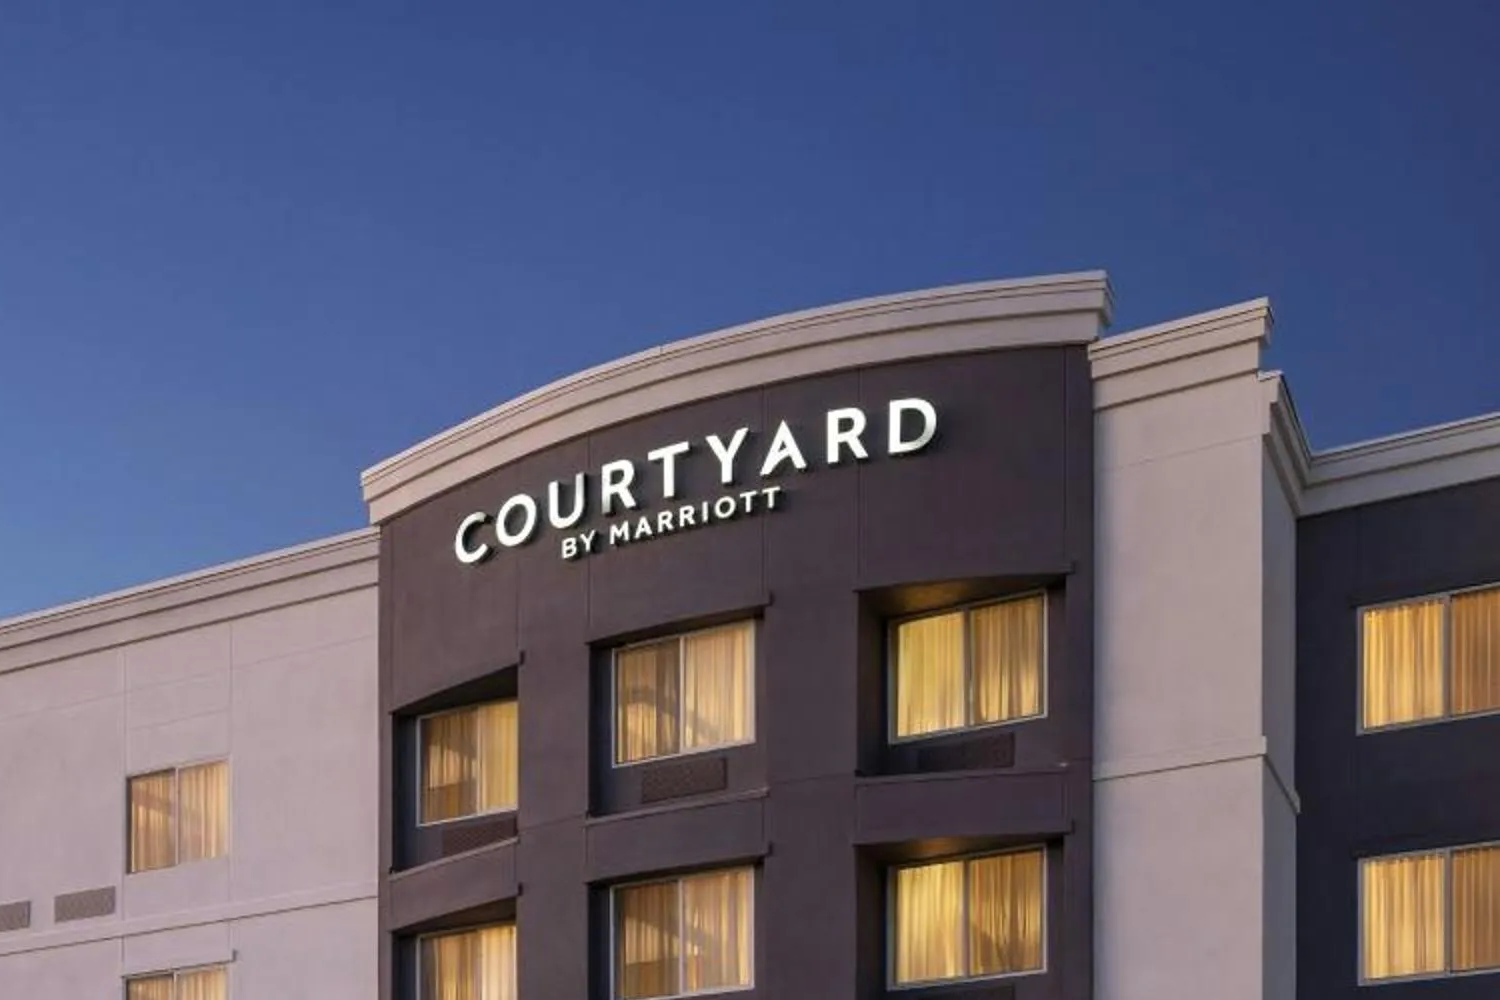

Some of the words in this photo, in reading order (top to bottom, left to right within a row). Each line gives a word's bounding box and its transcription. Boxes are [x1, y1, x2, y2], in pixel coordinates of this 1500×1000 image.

[454, 397, 939, 565] COURTYARD
[561, 529, 596, 559] BY
[609, 486, 782, 545] MARRIOTT
